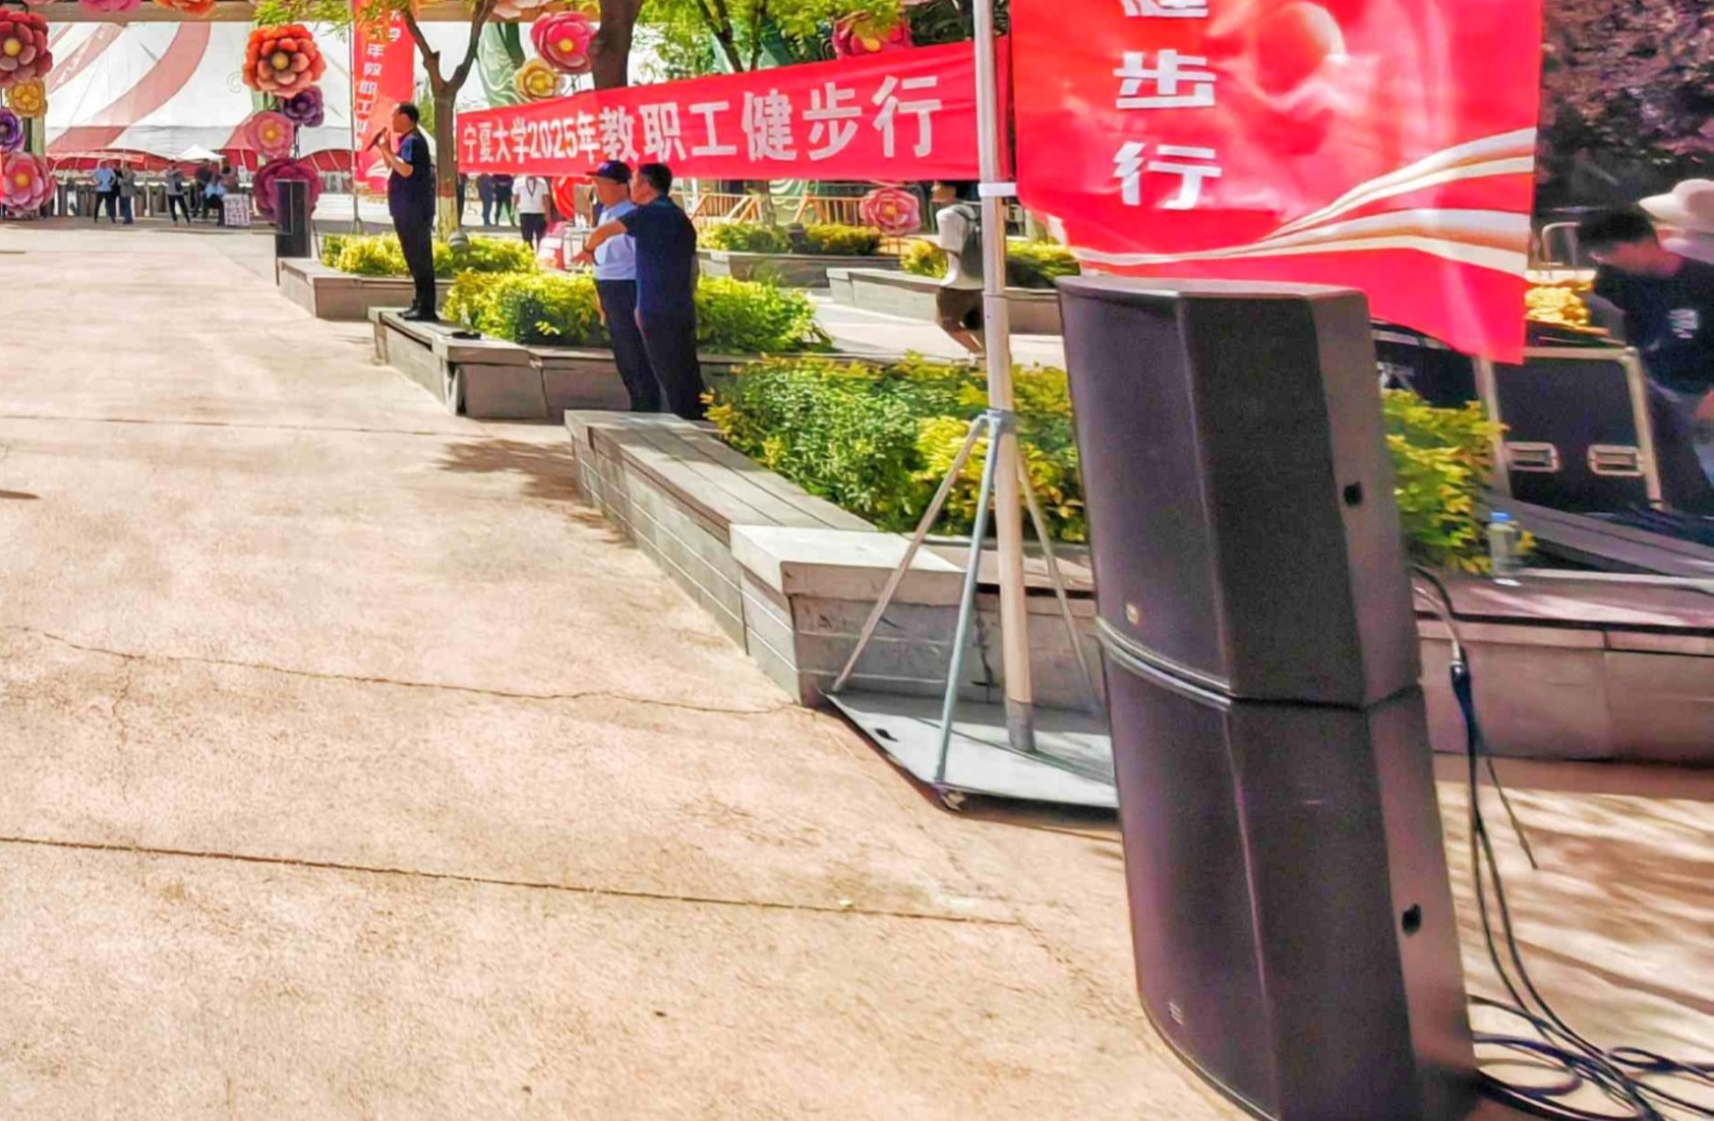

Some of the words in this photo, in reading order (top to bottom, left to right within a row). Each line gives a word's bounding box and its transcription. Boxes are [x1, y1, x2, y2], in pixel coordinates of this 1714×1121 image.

[463, 75, 943, 165] 宁夏大学2025年教职工健步行
